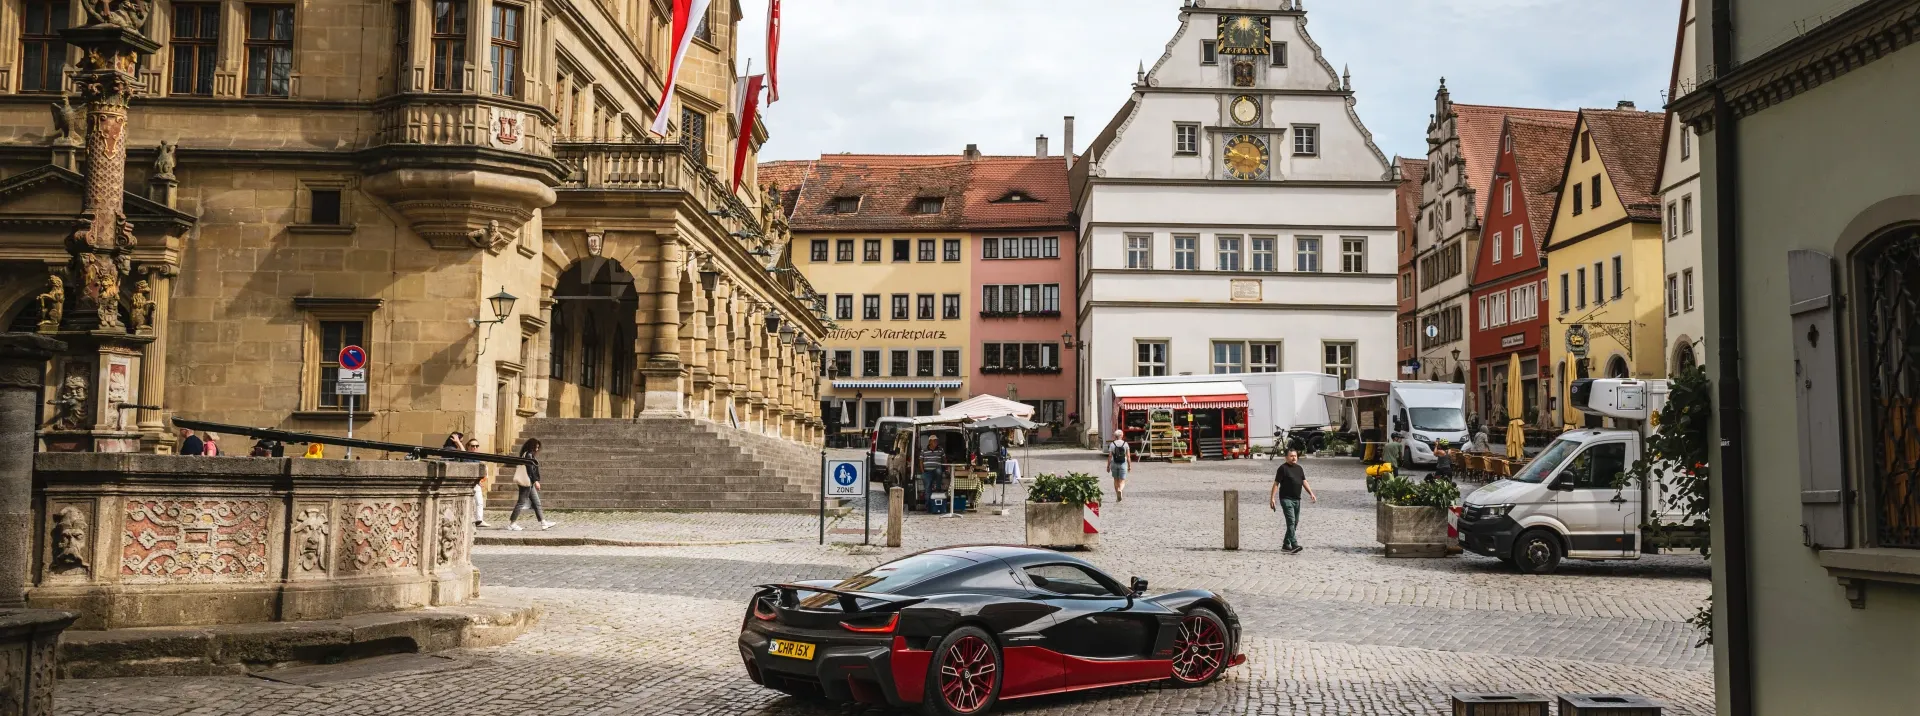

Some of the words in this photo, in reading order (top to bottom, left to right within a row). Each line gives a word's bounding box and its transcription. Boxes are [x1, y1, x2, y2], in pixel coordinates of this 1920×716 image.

[822, 328, 869, 342] asthof
[871, 328, 948, 341] Marktplatz
[778, 641, 795, 655] CHR
[794, 644, 810, 657] 15X
